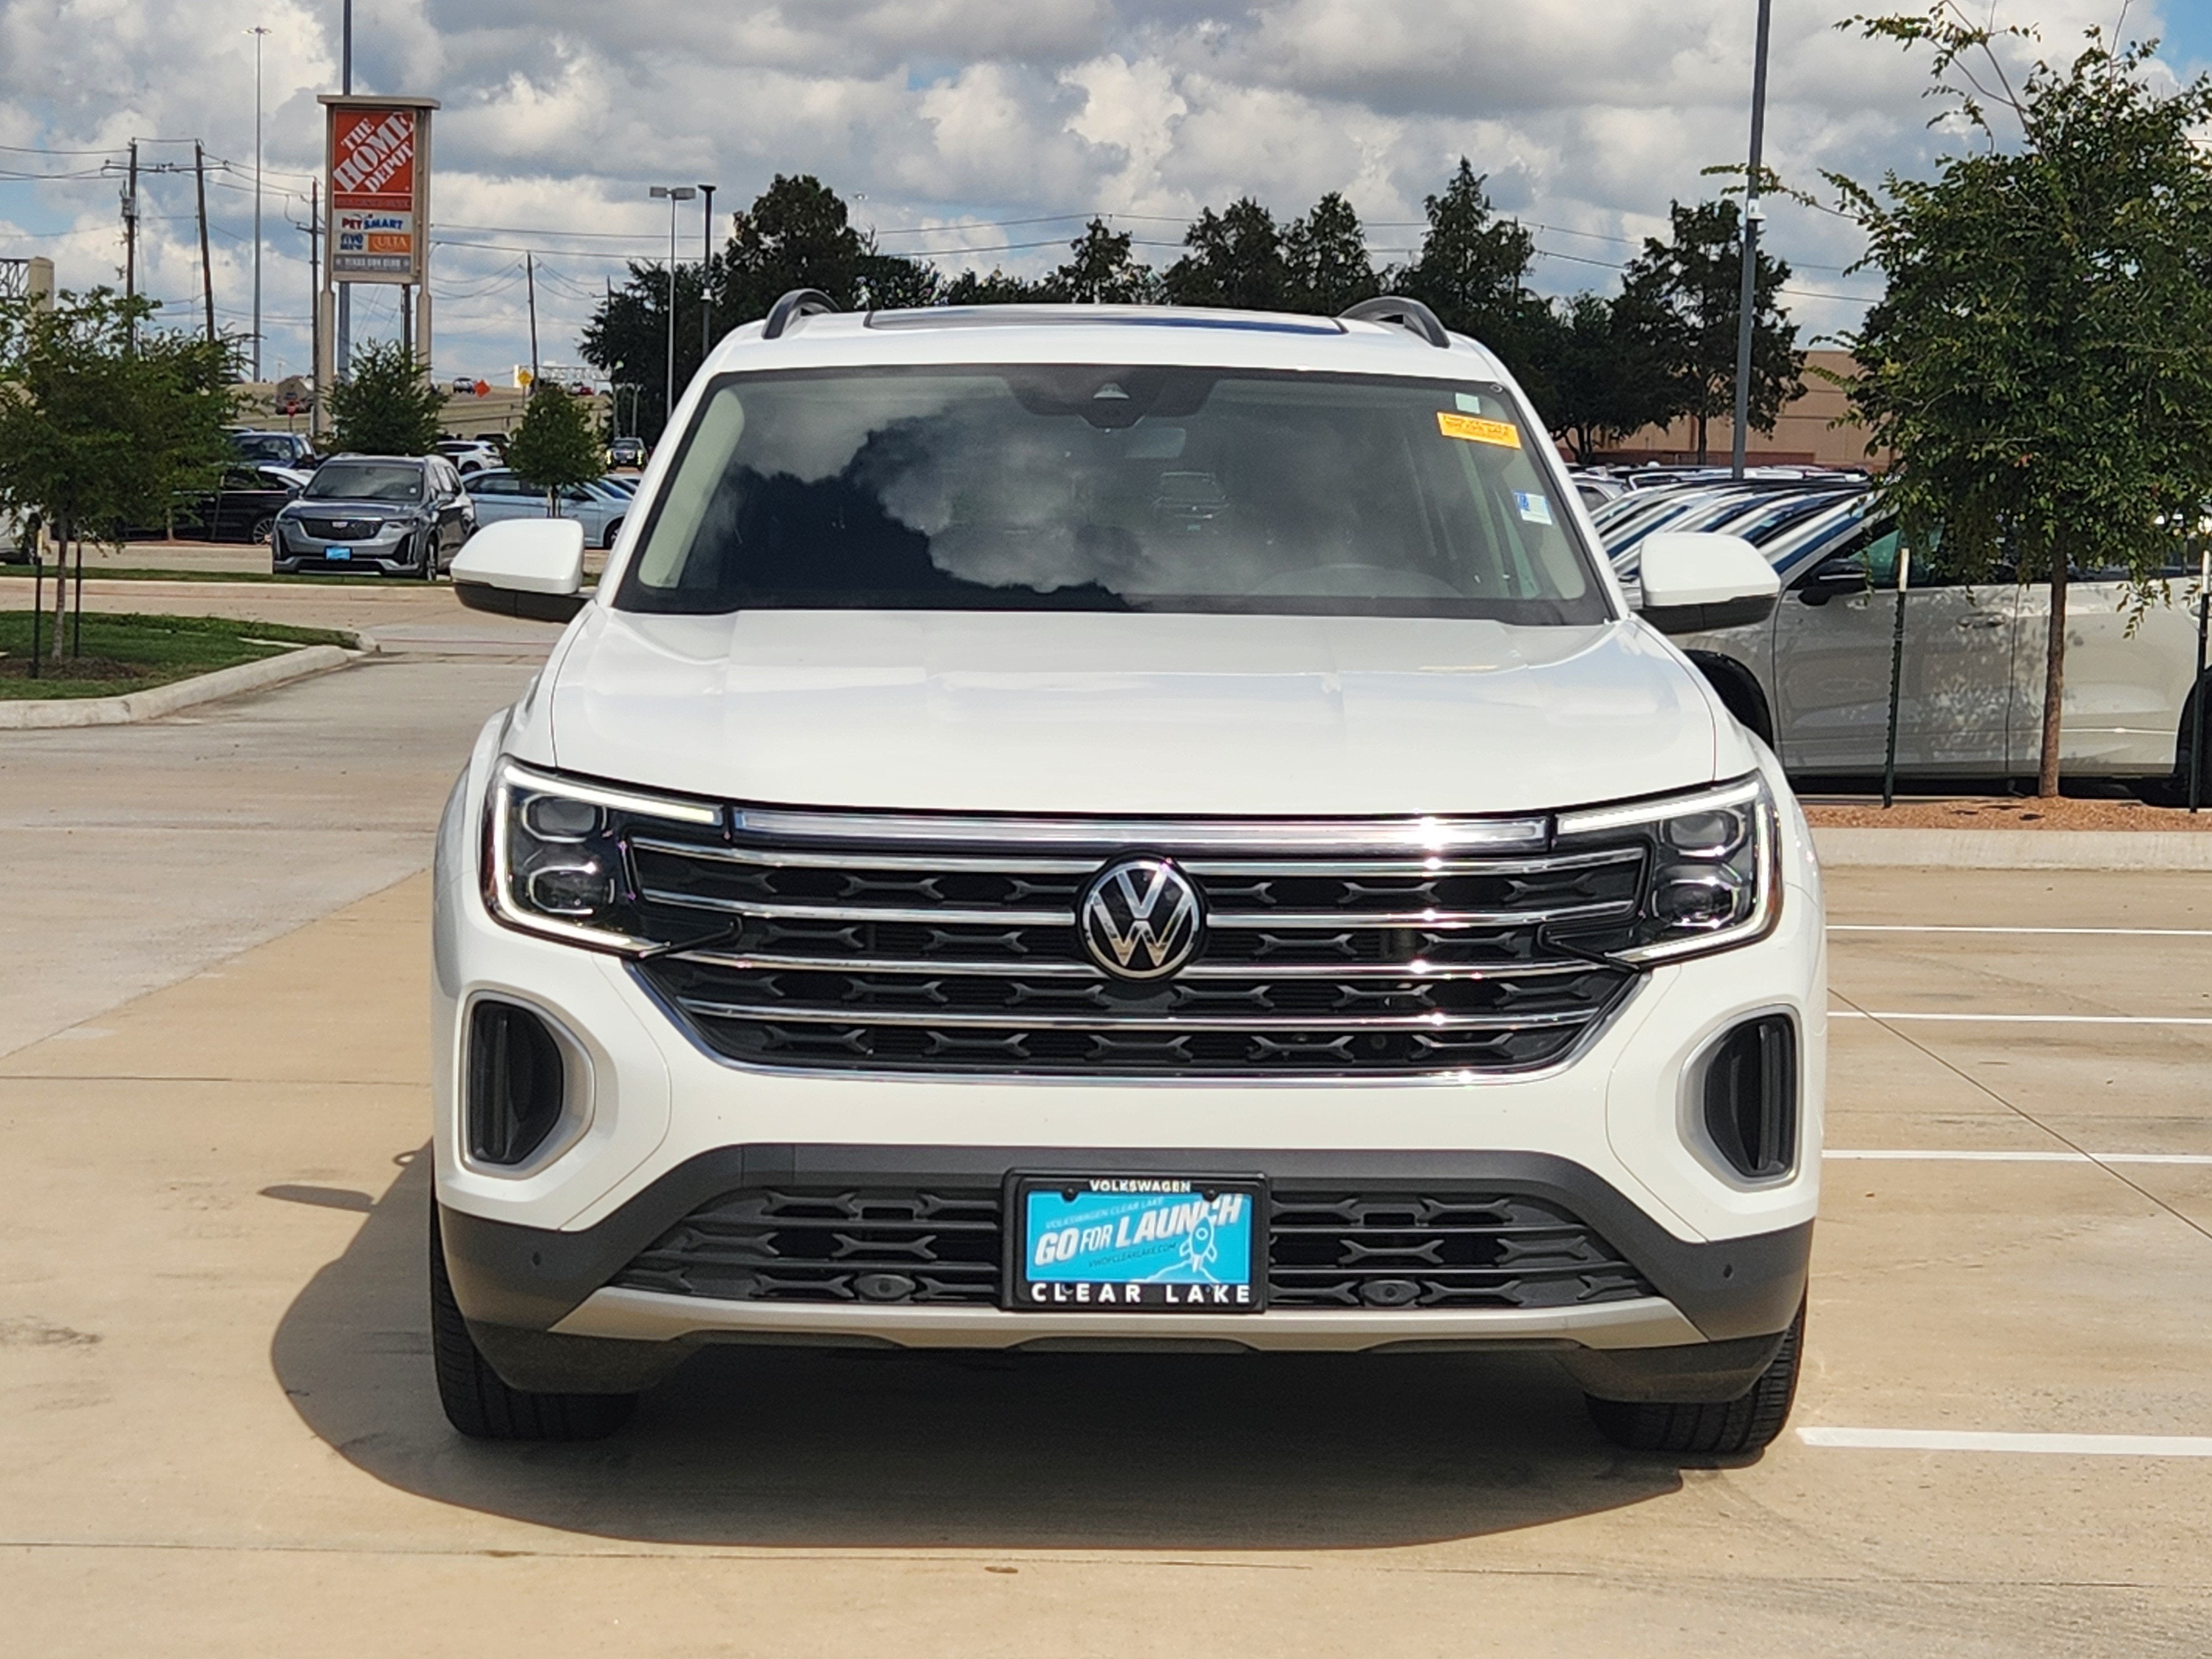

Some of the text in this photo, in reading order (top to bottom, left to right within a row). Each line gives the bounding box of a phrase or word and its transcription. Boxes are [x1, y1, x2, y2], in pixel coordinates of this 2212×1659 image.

[340, 118, 375, 151] THE
[332, 111, 414, 193] HOME
[364, 140, 413, 193] DEPOT
[374, 236, 408, 249] ULTA
[1087, 865, 1196, 972] VW
[1089, 1180, 1191, 1193] VOLKSWAGEN
[1110, 1201, 1140, 1215] CLEAR
[1141, 1196, 1164, 1209] LAKE
[1035, 1193, 1243, 1265] GO FOR LAUNCH
[1031, 1282, 1251, 1304] CLEAR LAKE
